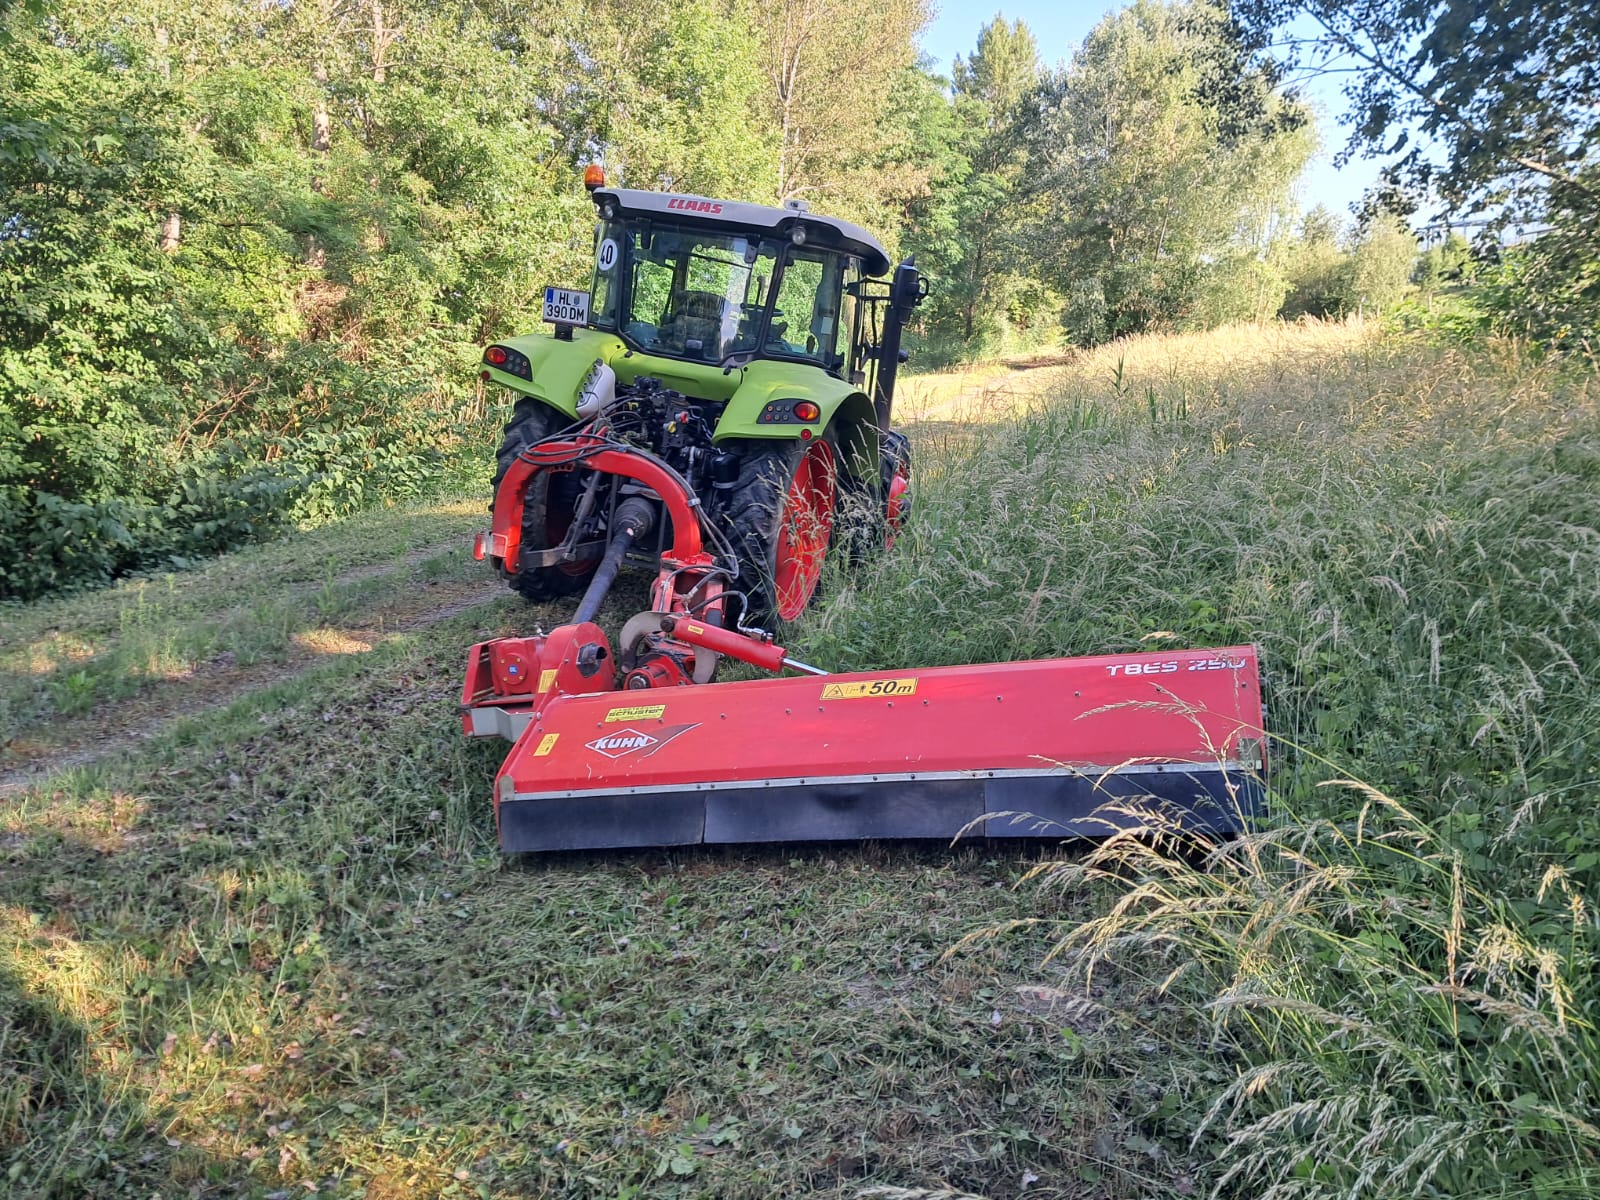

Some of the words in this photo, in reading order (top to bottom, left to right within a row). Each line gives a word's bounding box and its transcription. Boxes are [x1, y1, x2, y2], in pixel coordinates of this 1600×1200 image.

[667, 198, 723, 214] CLAAS
[600, 244, 613, 265] 40
[558, 291, 571, 305] HL
[546, 304, 568, 319] 390
[569, 306, 585, 321] DM
[1106, 661, 1178, 676] TBES
[595, 736, 650, 749] KUHN
